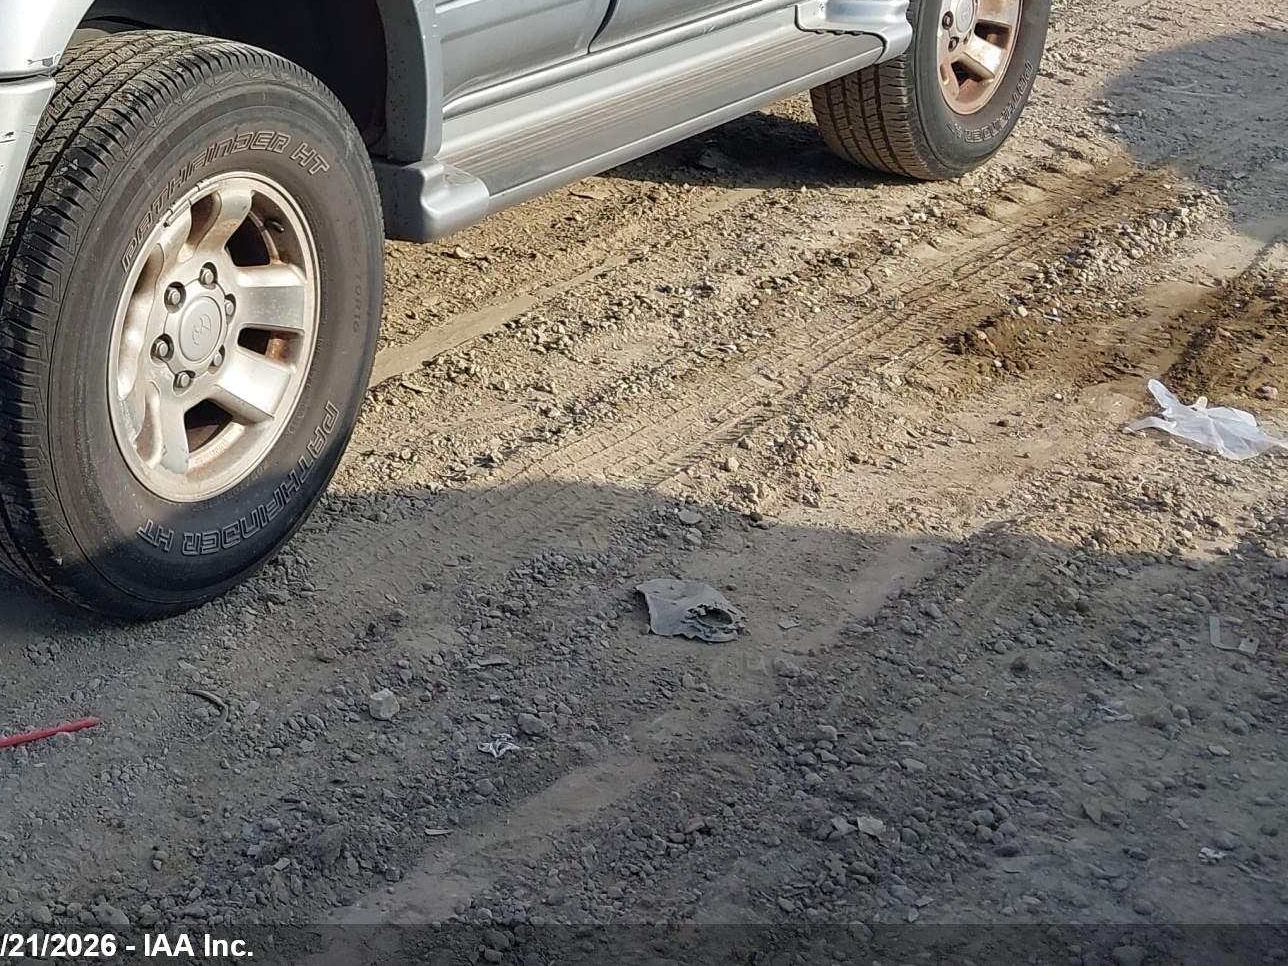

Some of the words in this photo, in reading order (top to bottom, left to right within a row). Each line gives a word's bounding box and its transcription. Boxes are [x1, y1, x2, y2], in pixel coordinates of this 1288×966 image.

[120, 130, 291, 273] PATHFINDER
[289, 142, 330, 176] HT
[136, 518, 174, 552] HT
[181, 400, 340, 556] PATHFINDER
